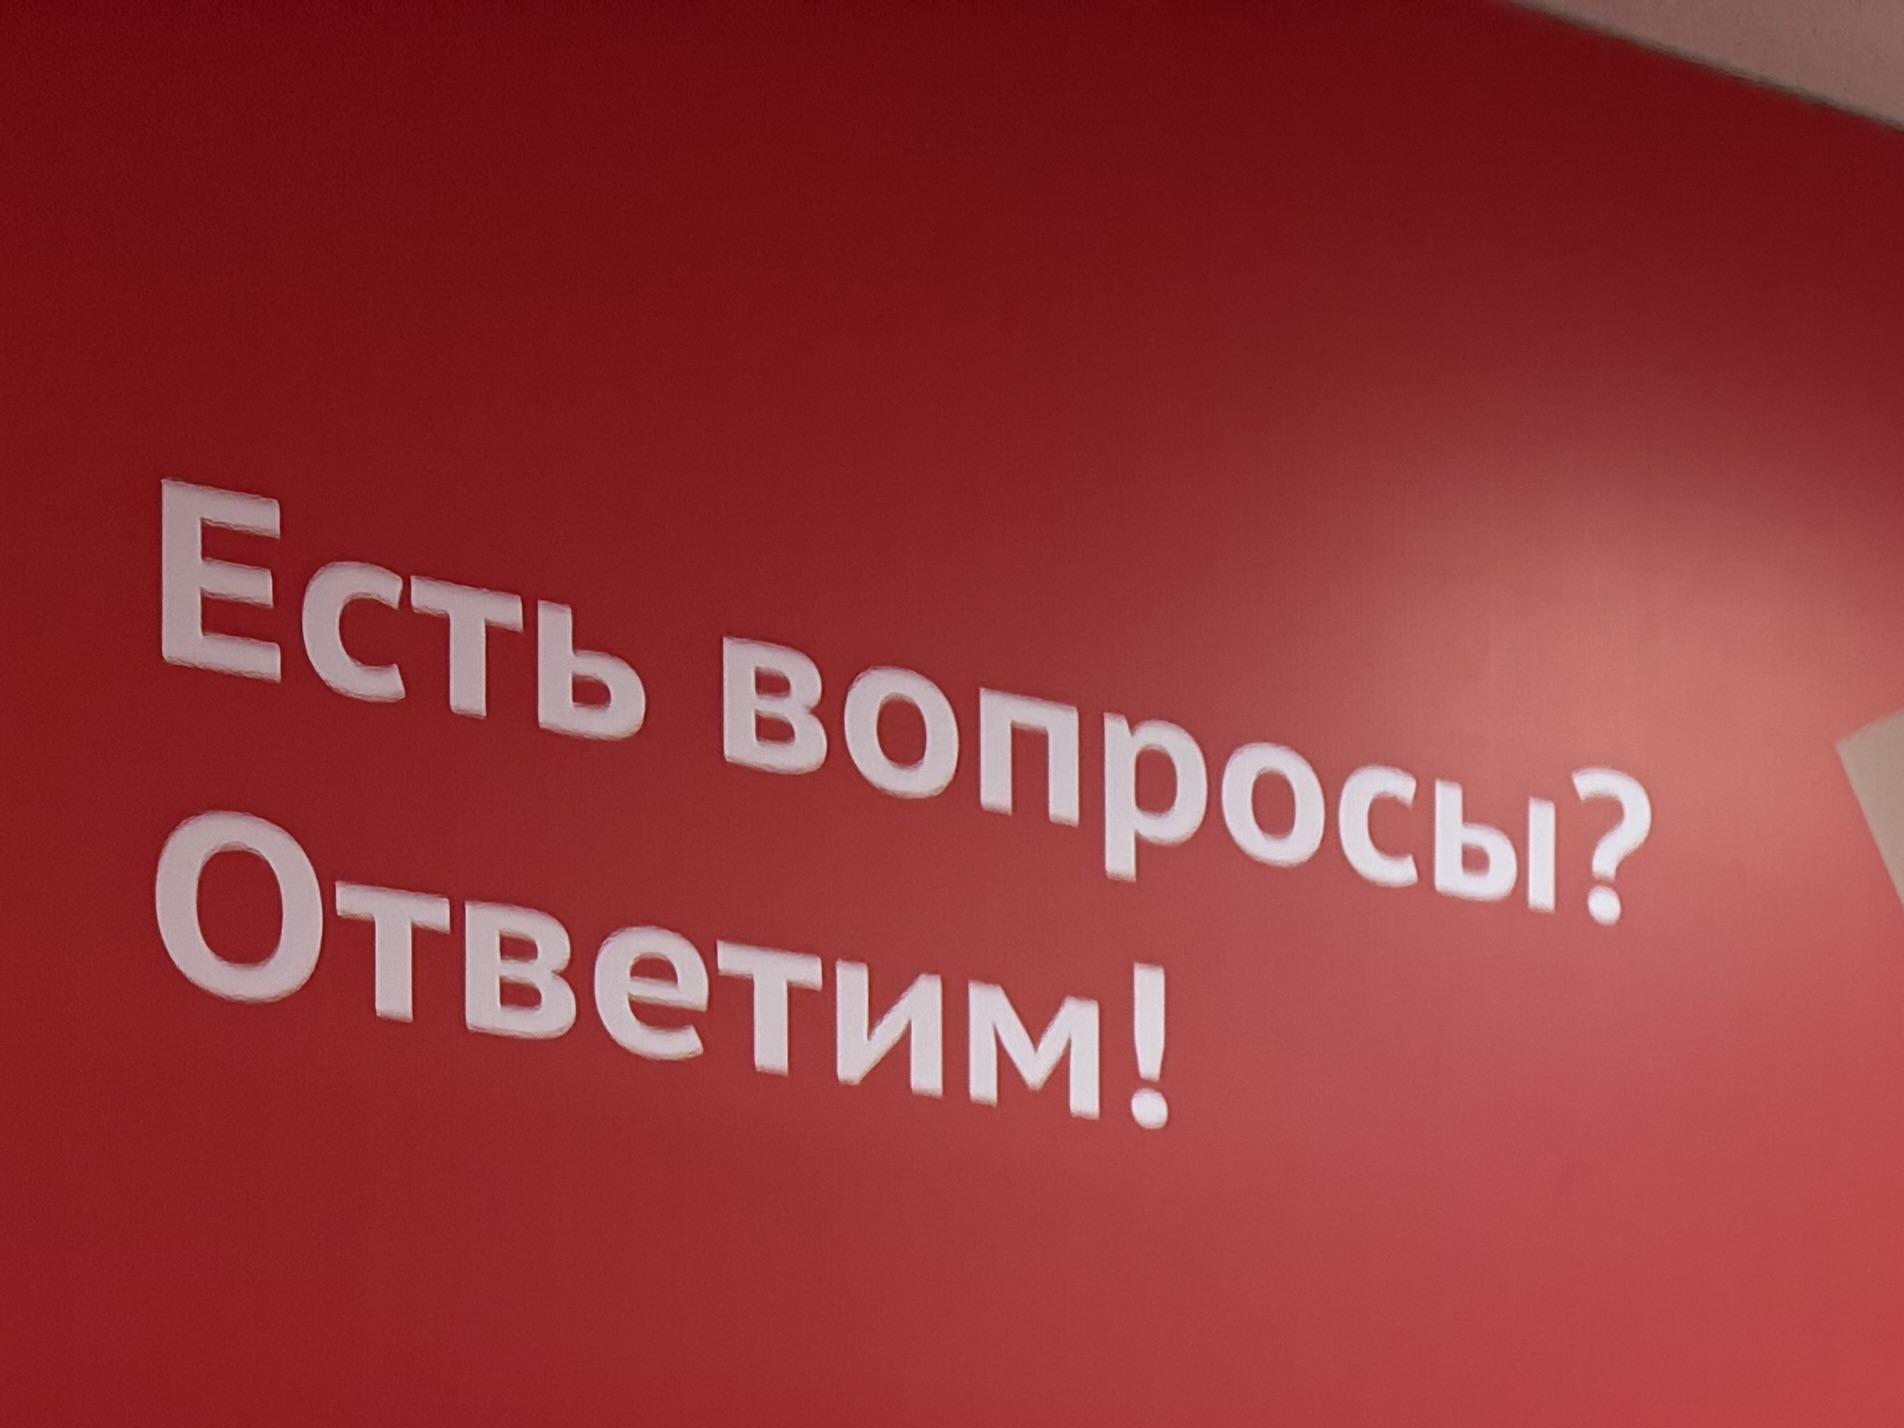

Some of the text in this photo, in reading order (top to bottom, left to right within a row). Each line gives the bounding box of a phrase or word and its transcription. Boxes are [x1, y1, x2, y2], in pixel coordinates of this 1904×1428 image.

[160, 478, 1654, 928] Есть вопросы?
[153, 809, 1171, 1130] Ответим!
